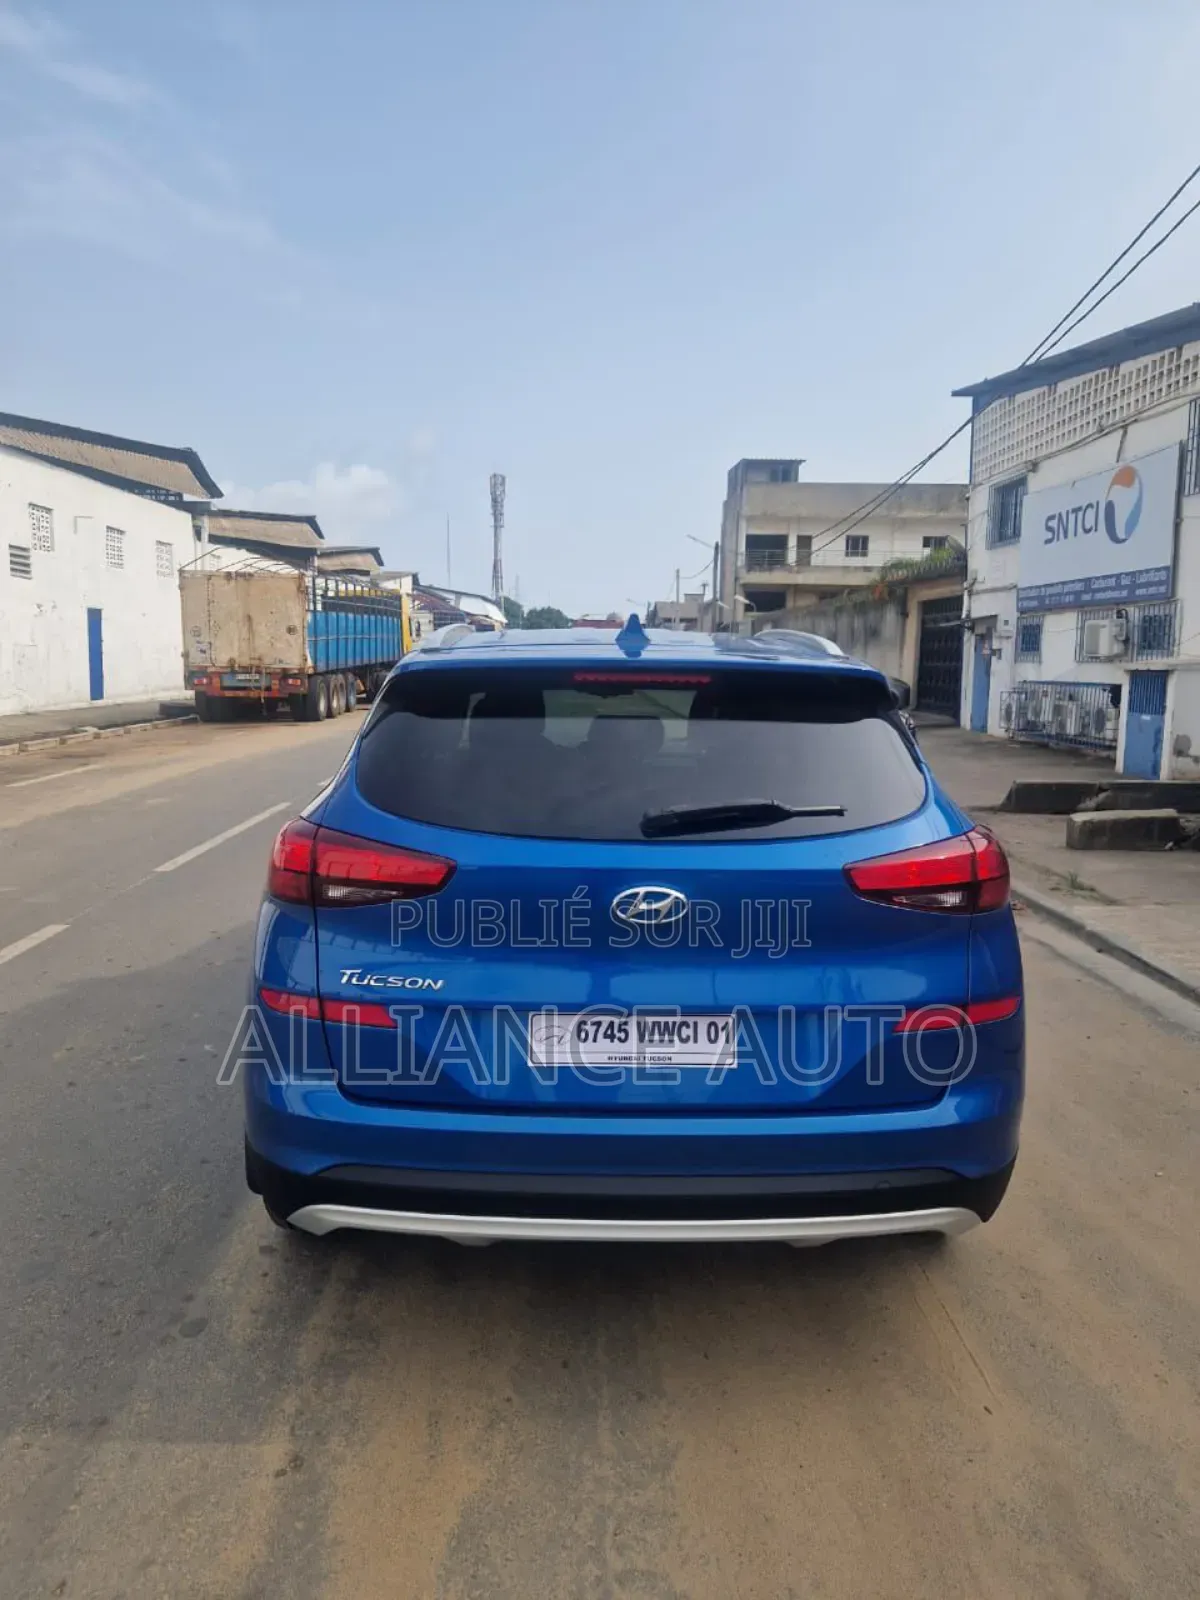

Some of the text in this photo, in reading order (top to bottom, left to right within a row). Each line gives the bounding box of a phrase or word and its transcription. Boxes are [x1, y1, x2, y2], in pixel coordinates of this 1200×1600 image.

[1044, 500, 1099, 545] SNTCI
[339, 968, 446, 991] TUCSON
[576, 1019, 730, 1044] 6745 WWCI 01
